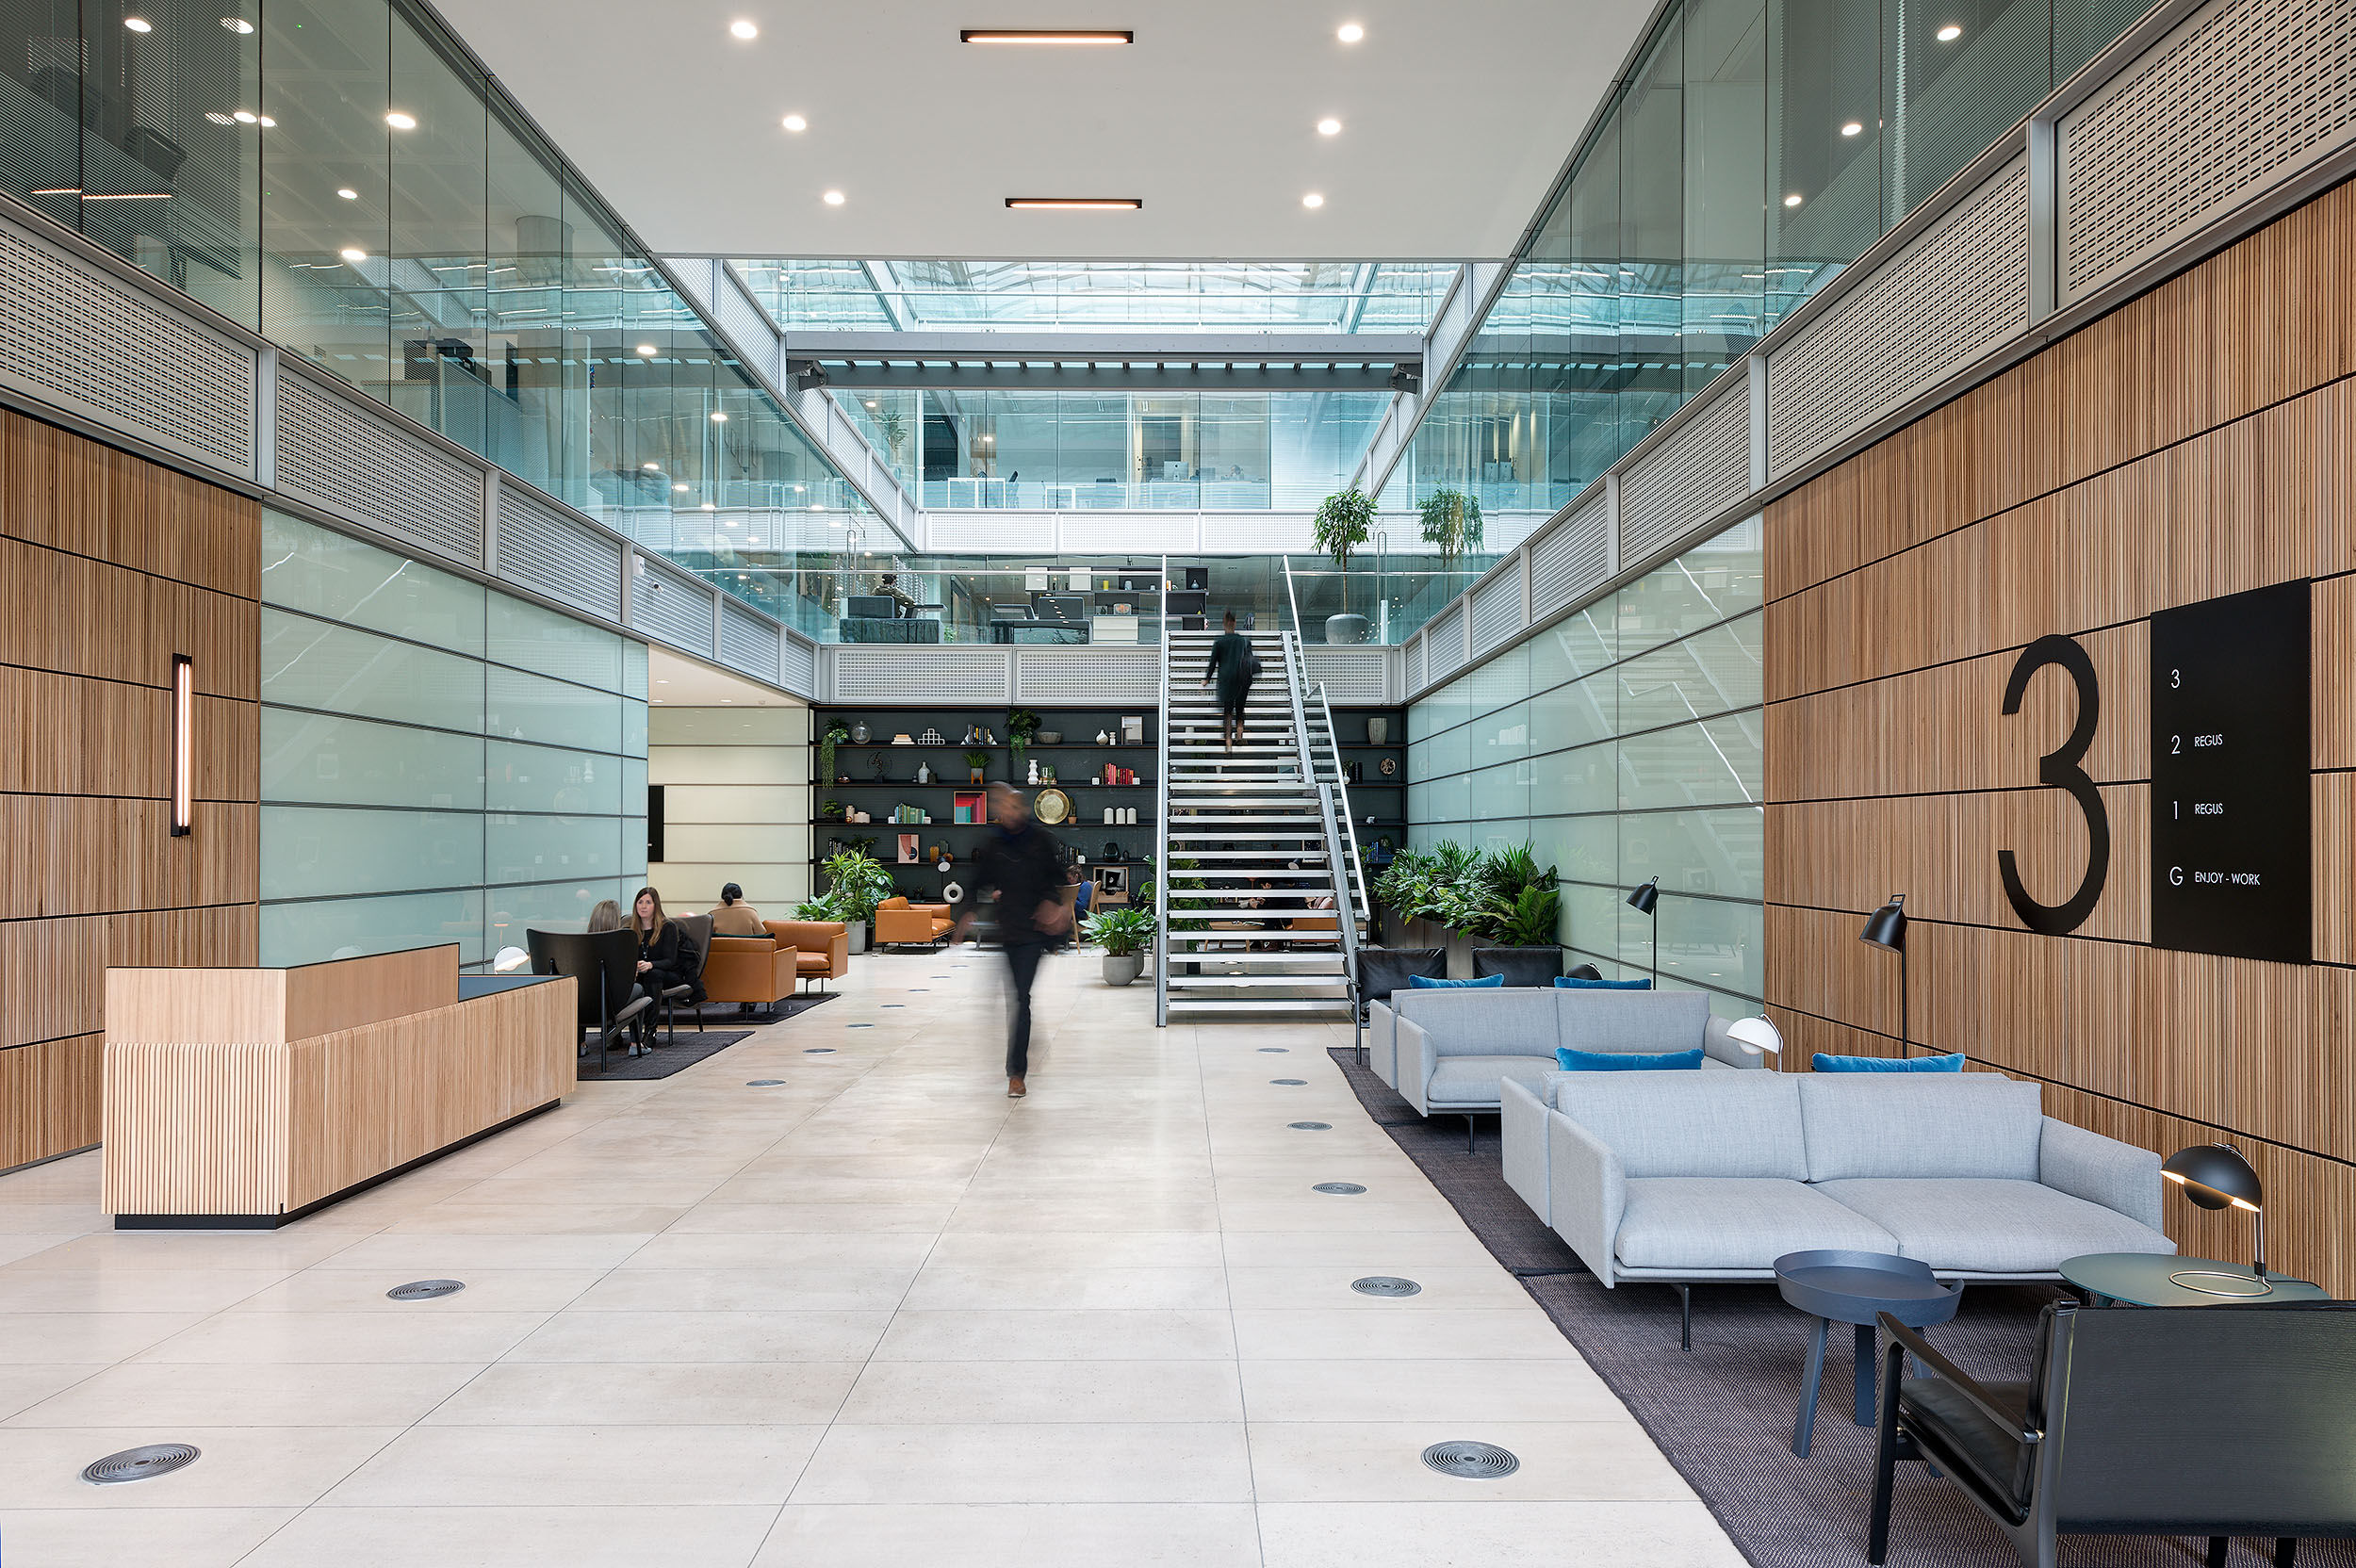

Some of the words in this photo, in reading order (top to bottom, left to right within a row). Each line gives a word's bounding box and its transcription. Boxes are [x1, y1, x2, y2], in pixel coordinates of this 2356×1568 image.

[2170, 668, 2181, 689] 3
[2171, 734, 2181, 755] 2
[2194, 733, 2223, 747] REGUS
[1998, 633, 2110, 935] 3
[2172, 800, 2178, 820] 1
[2194, 803, 2223, 815] REGUS
[2169, 866, 2184, 886] G
